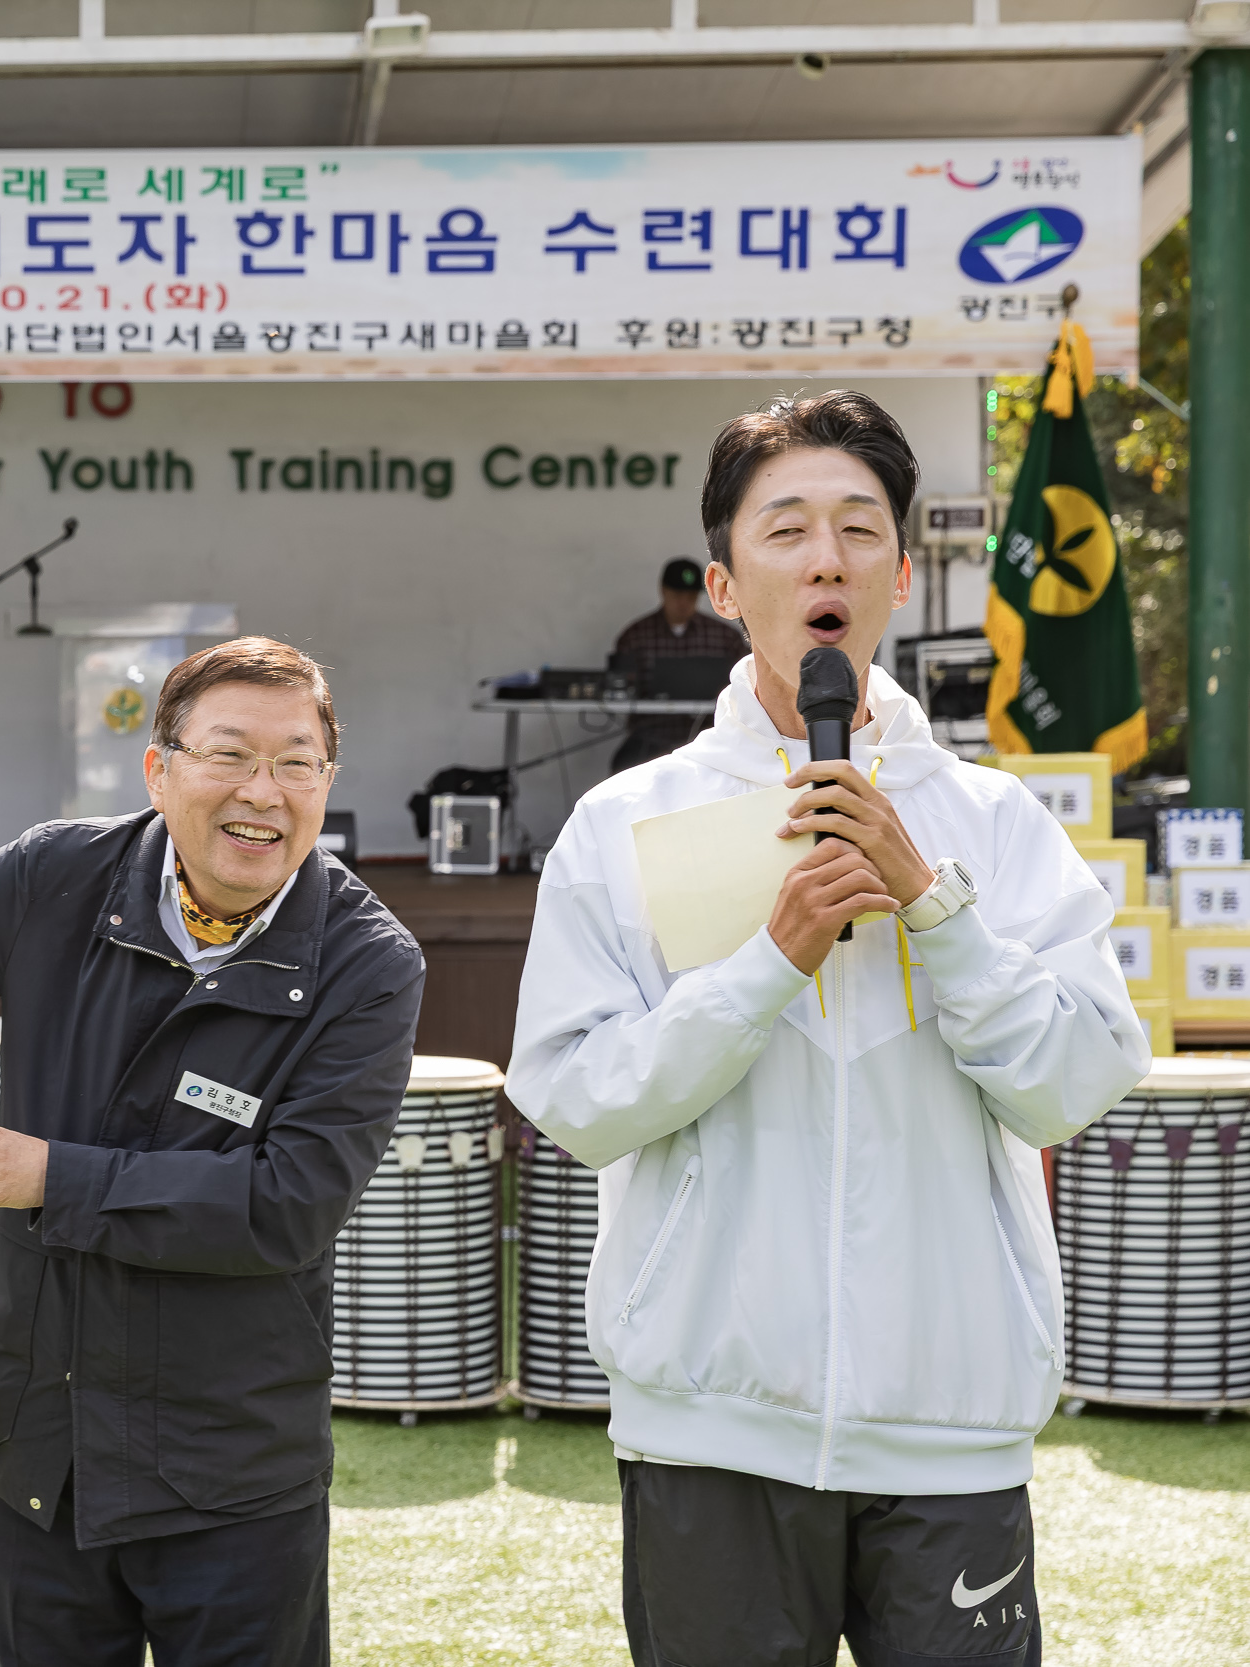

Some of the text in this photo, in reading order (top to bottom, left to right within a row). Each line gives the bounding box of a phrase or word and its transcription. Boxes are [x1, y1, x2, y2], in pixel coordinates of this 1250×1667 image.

[234, 206, 500, 277] 한마음
[542, 202, 910, 272] 수련대회
[616, 316, 913, 350] 후원:광진구청
[38, 448, 196, 493] Youth
[229, 446, 455, 500] Training
[480, 445, 682, 489] Center
[972, 1603, 1027, 1628] AIR
